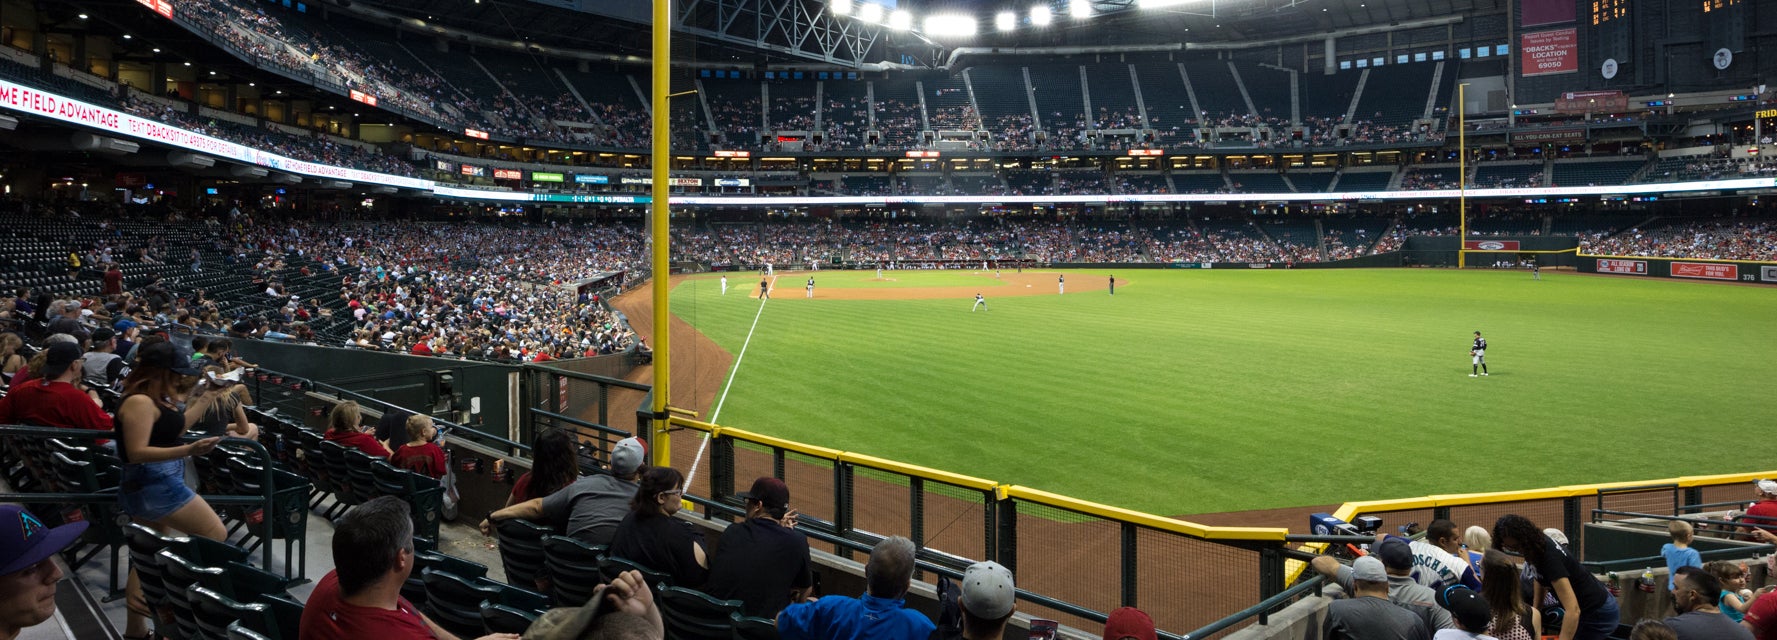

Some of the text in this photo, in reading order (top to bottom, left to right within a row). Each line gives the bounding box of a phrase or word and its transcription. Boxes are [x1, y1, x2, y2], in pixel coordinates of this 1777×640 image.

[1532, 50, 1567, 59] LOCATION
[1538, 61, 1562, 69] 69050
[22, 90, 56, 113] FIELD
[59, 101, 119, 129] ADVANTAGE
[128, 119, 145, 133] TEXT
[1743, 274, 1755, 282] 376
